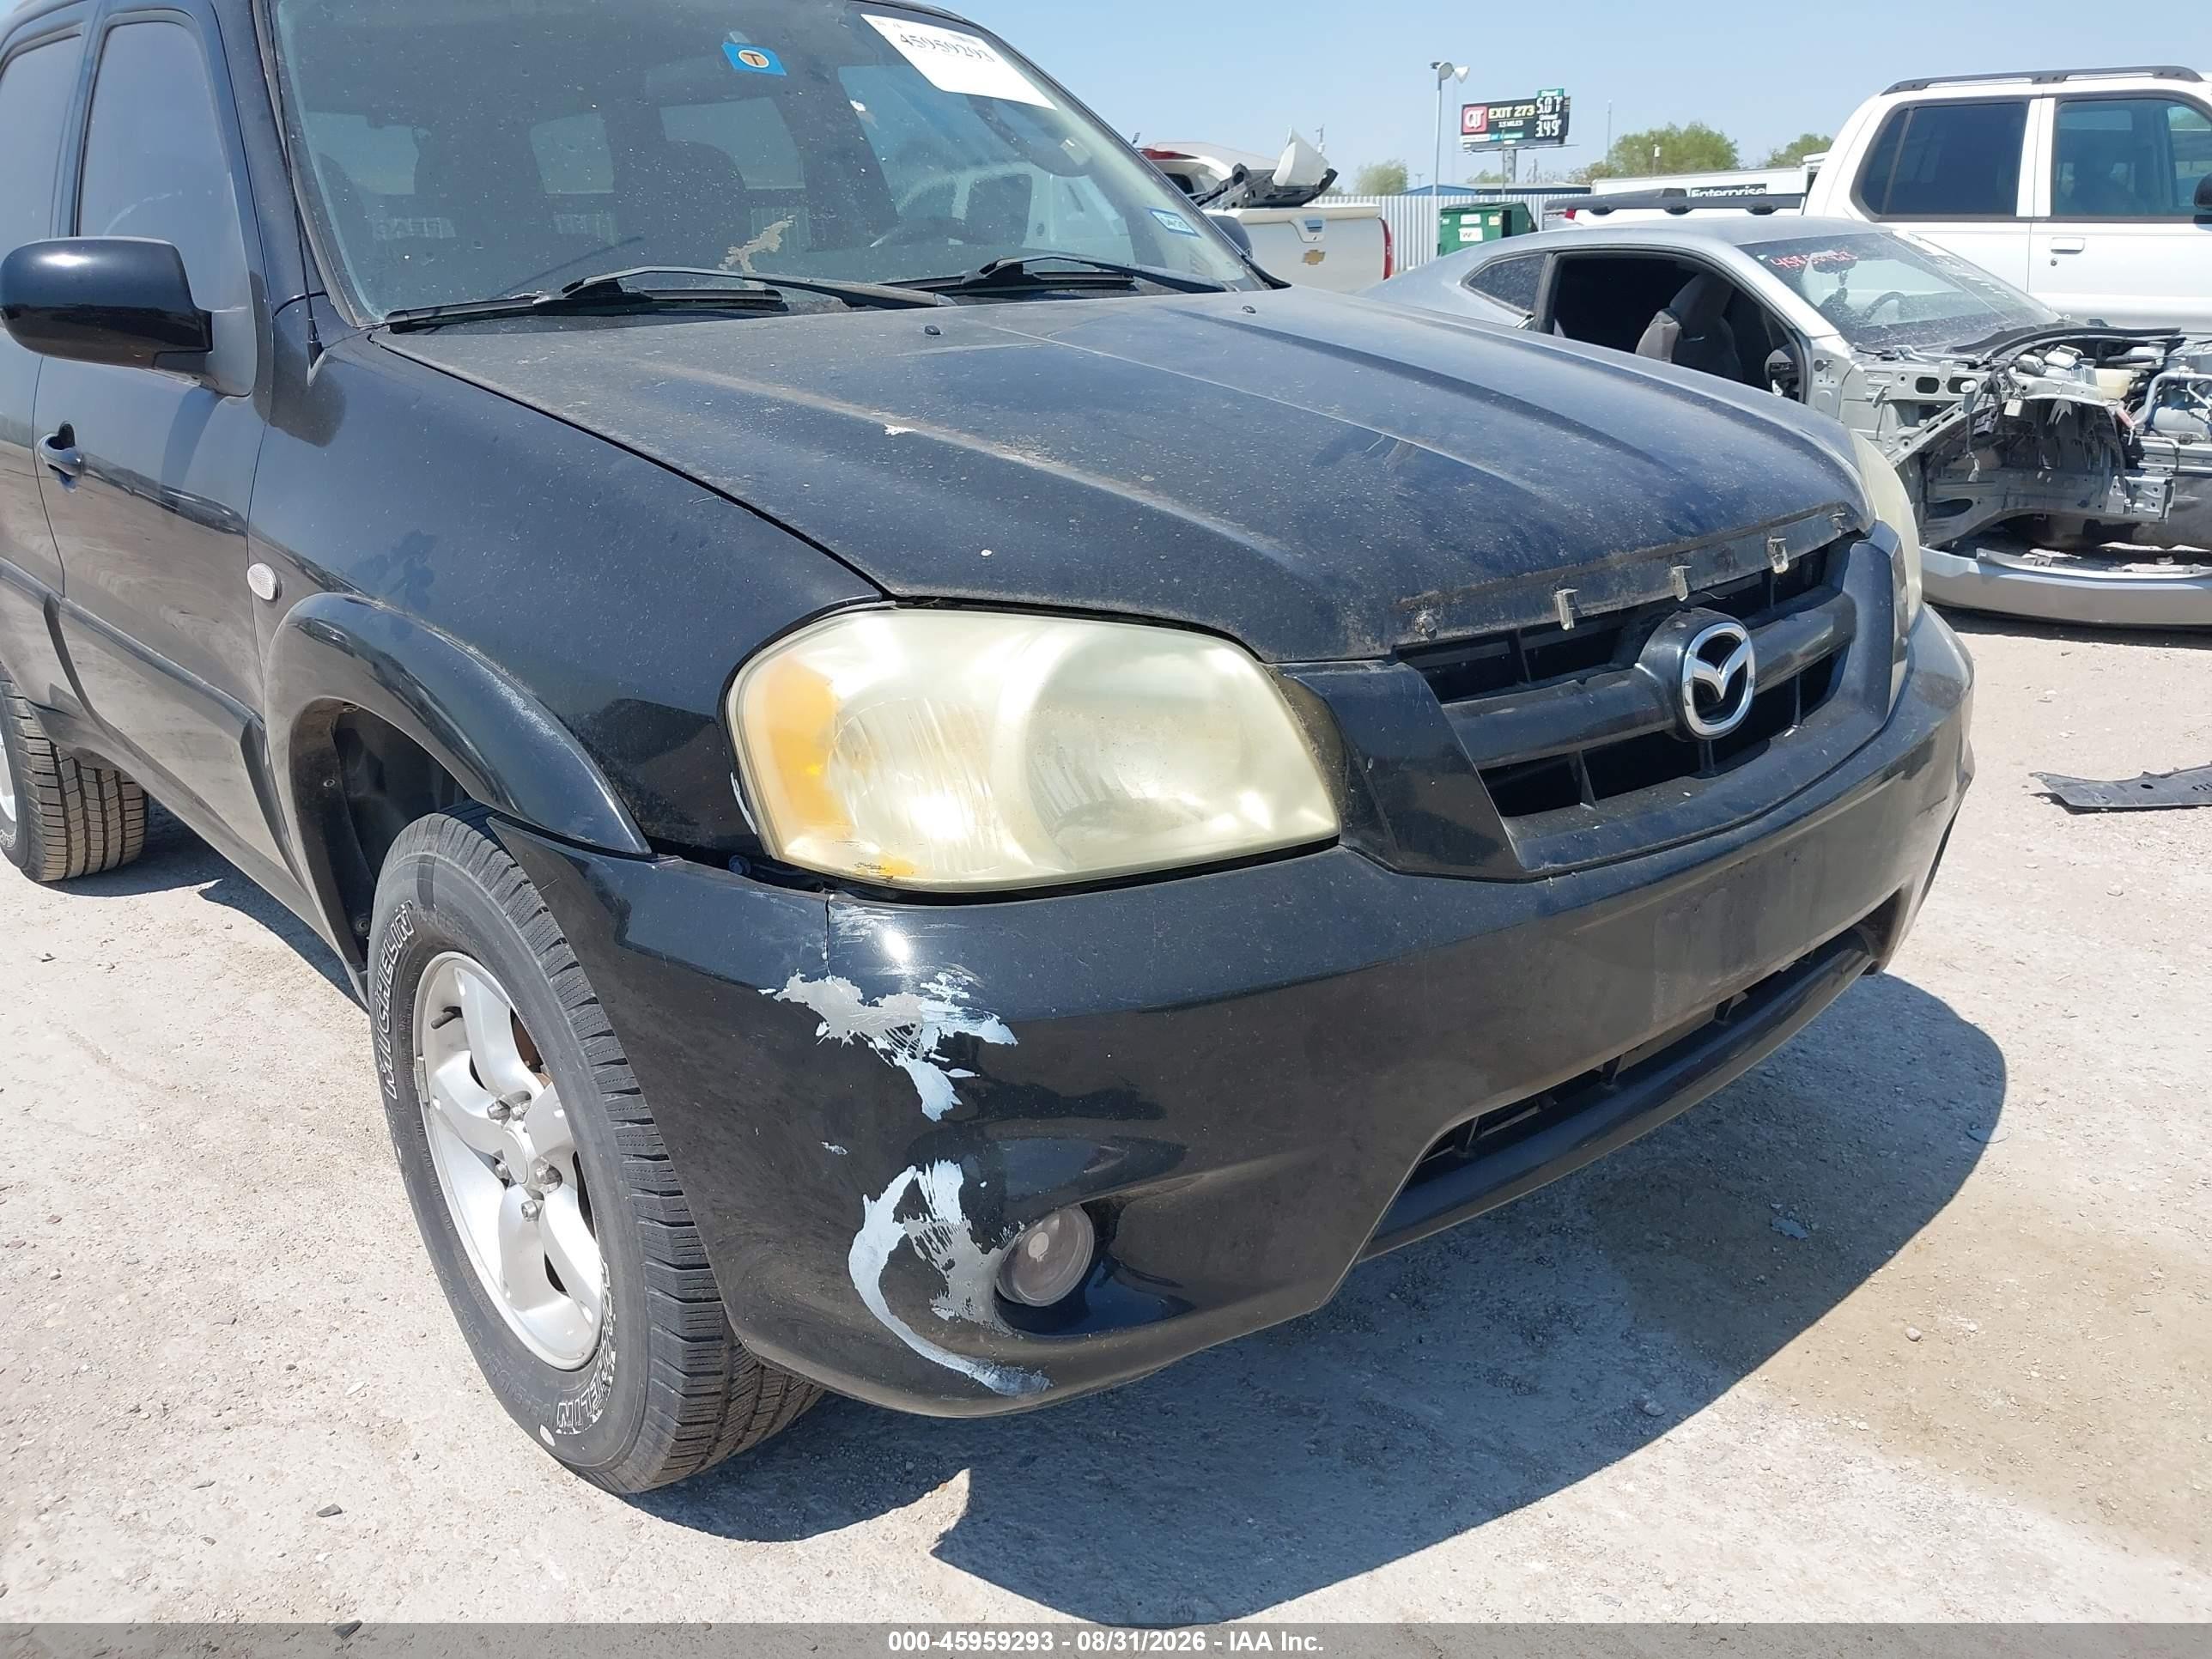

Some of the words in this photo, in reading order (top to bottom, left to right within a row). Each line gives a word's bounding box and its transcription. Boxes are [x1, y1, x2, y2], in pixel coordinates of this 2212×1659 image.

[1488, 106, 1512, 118] EXIT
[1514, 105, 1534, 117] 273
[375, 908, 416, 1100] MICHELIN
